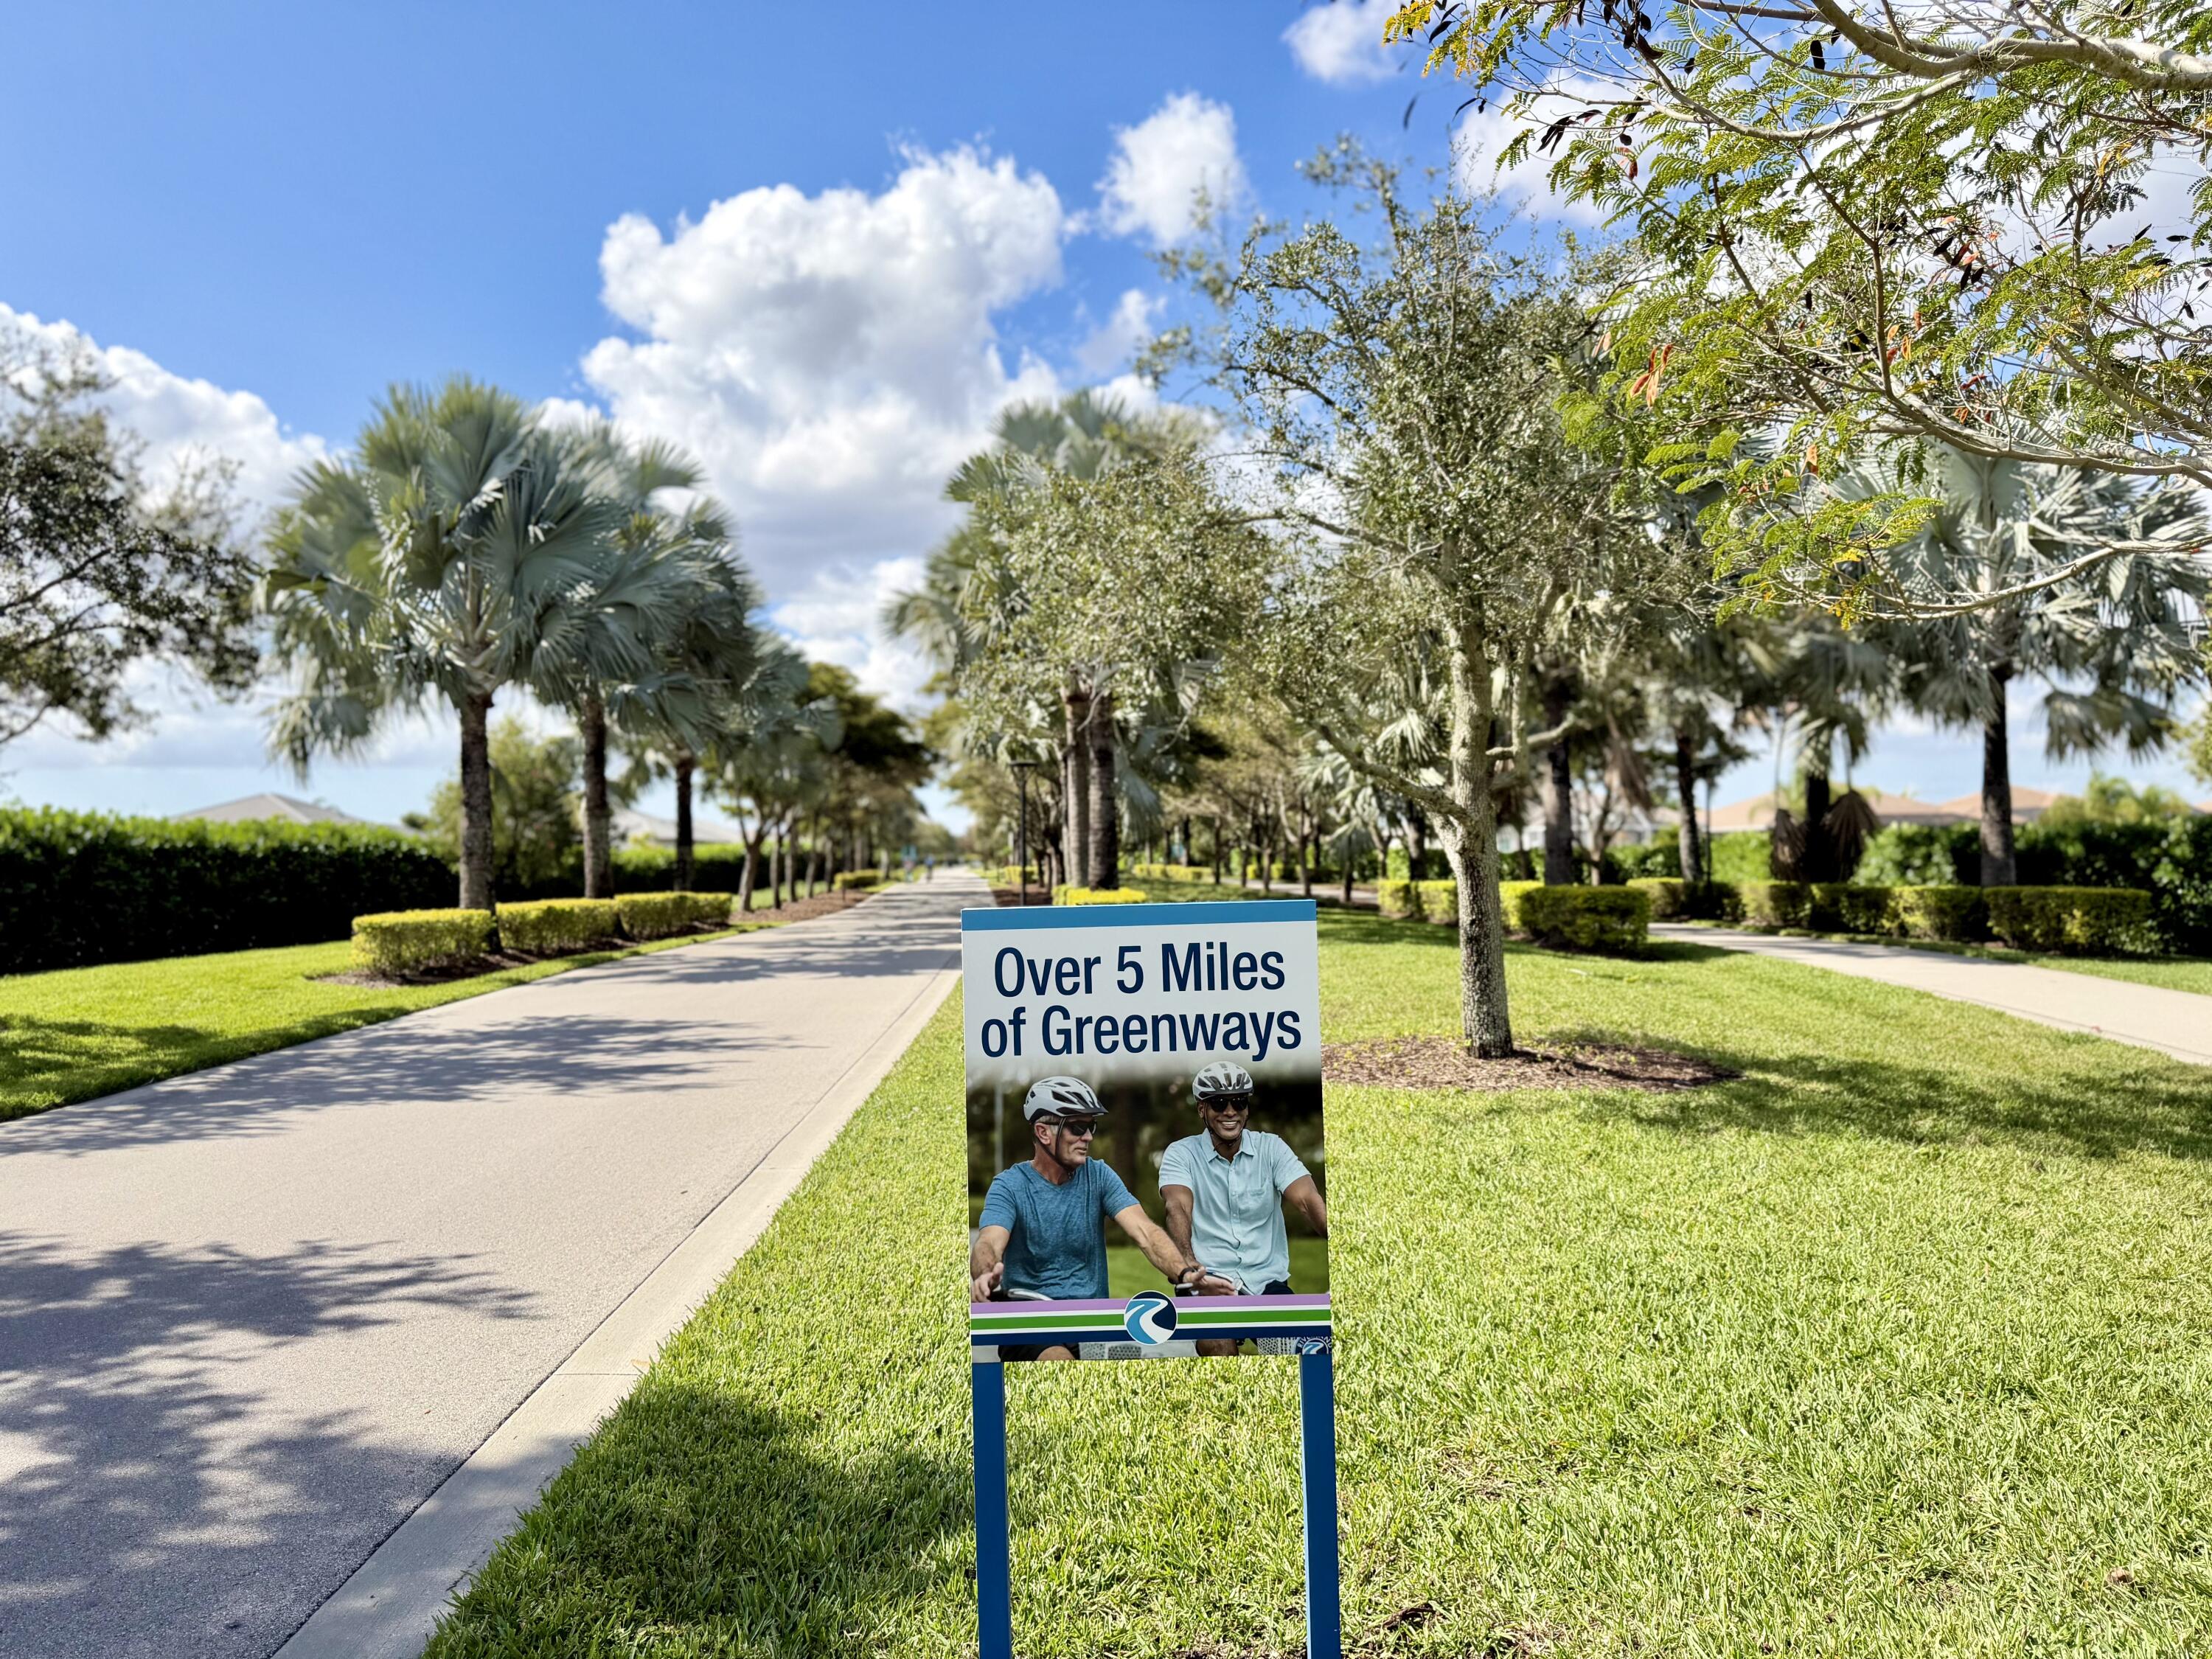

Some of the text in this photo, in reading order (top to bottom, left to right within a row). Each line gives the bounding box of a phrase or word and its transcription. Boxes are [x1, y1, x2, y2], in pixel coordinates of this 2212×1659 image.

[995, 941, 1285, 998] Over 5 Miles
[981, 1005, 1302, 1062] of Greenways
[1298, 1336, 1332, 1349] RIVND
